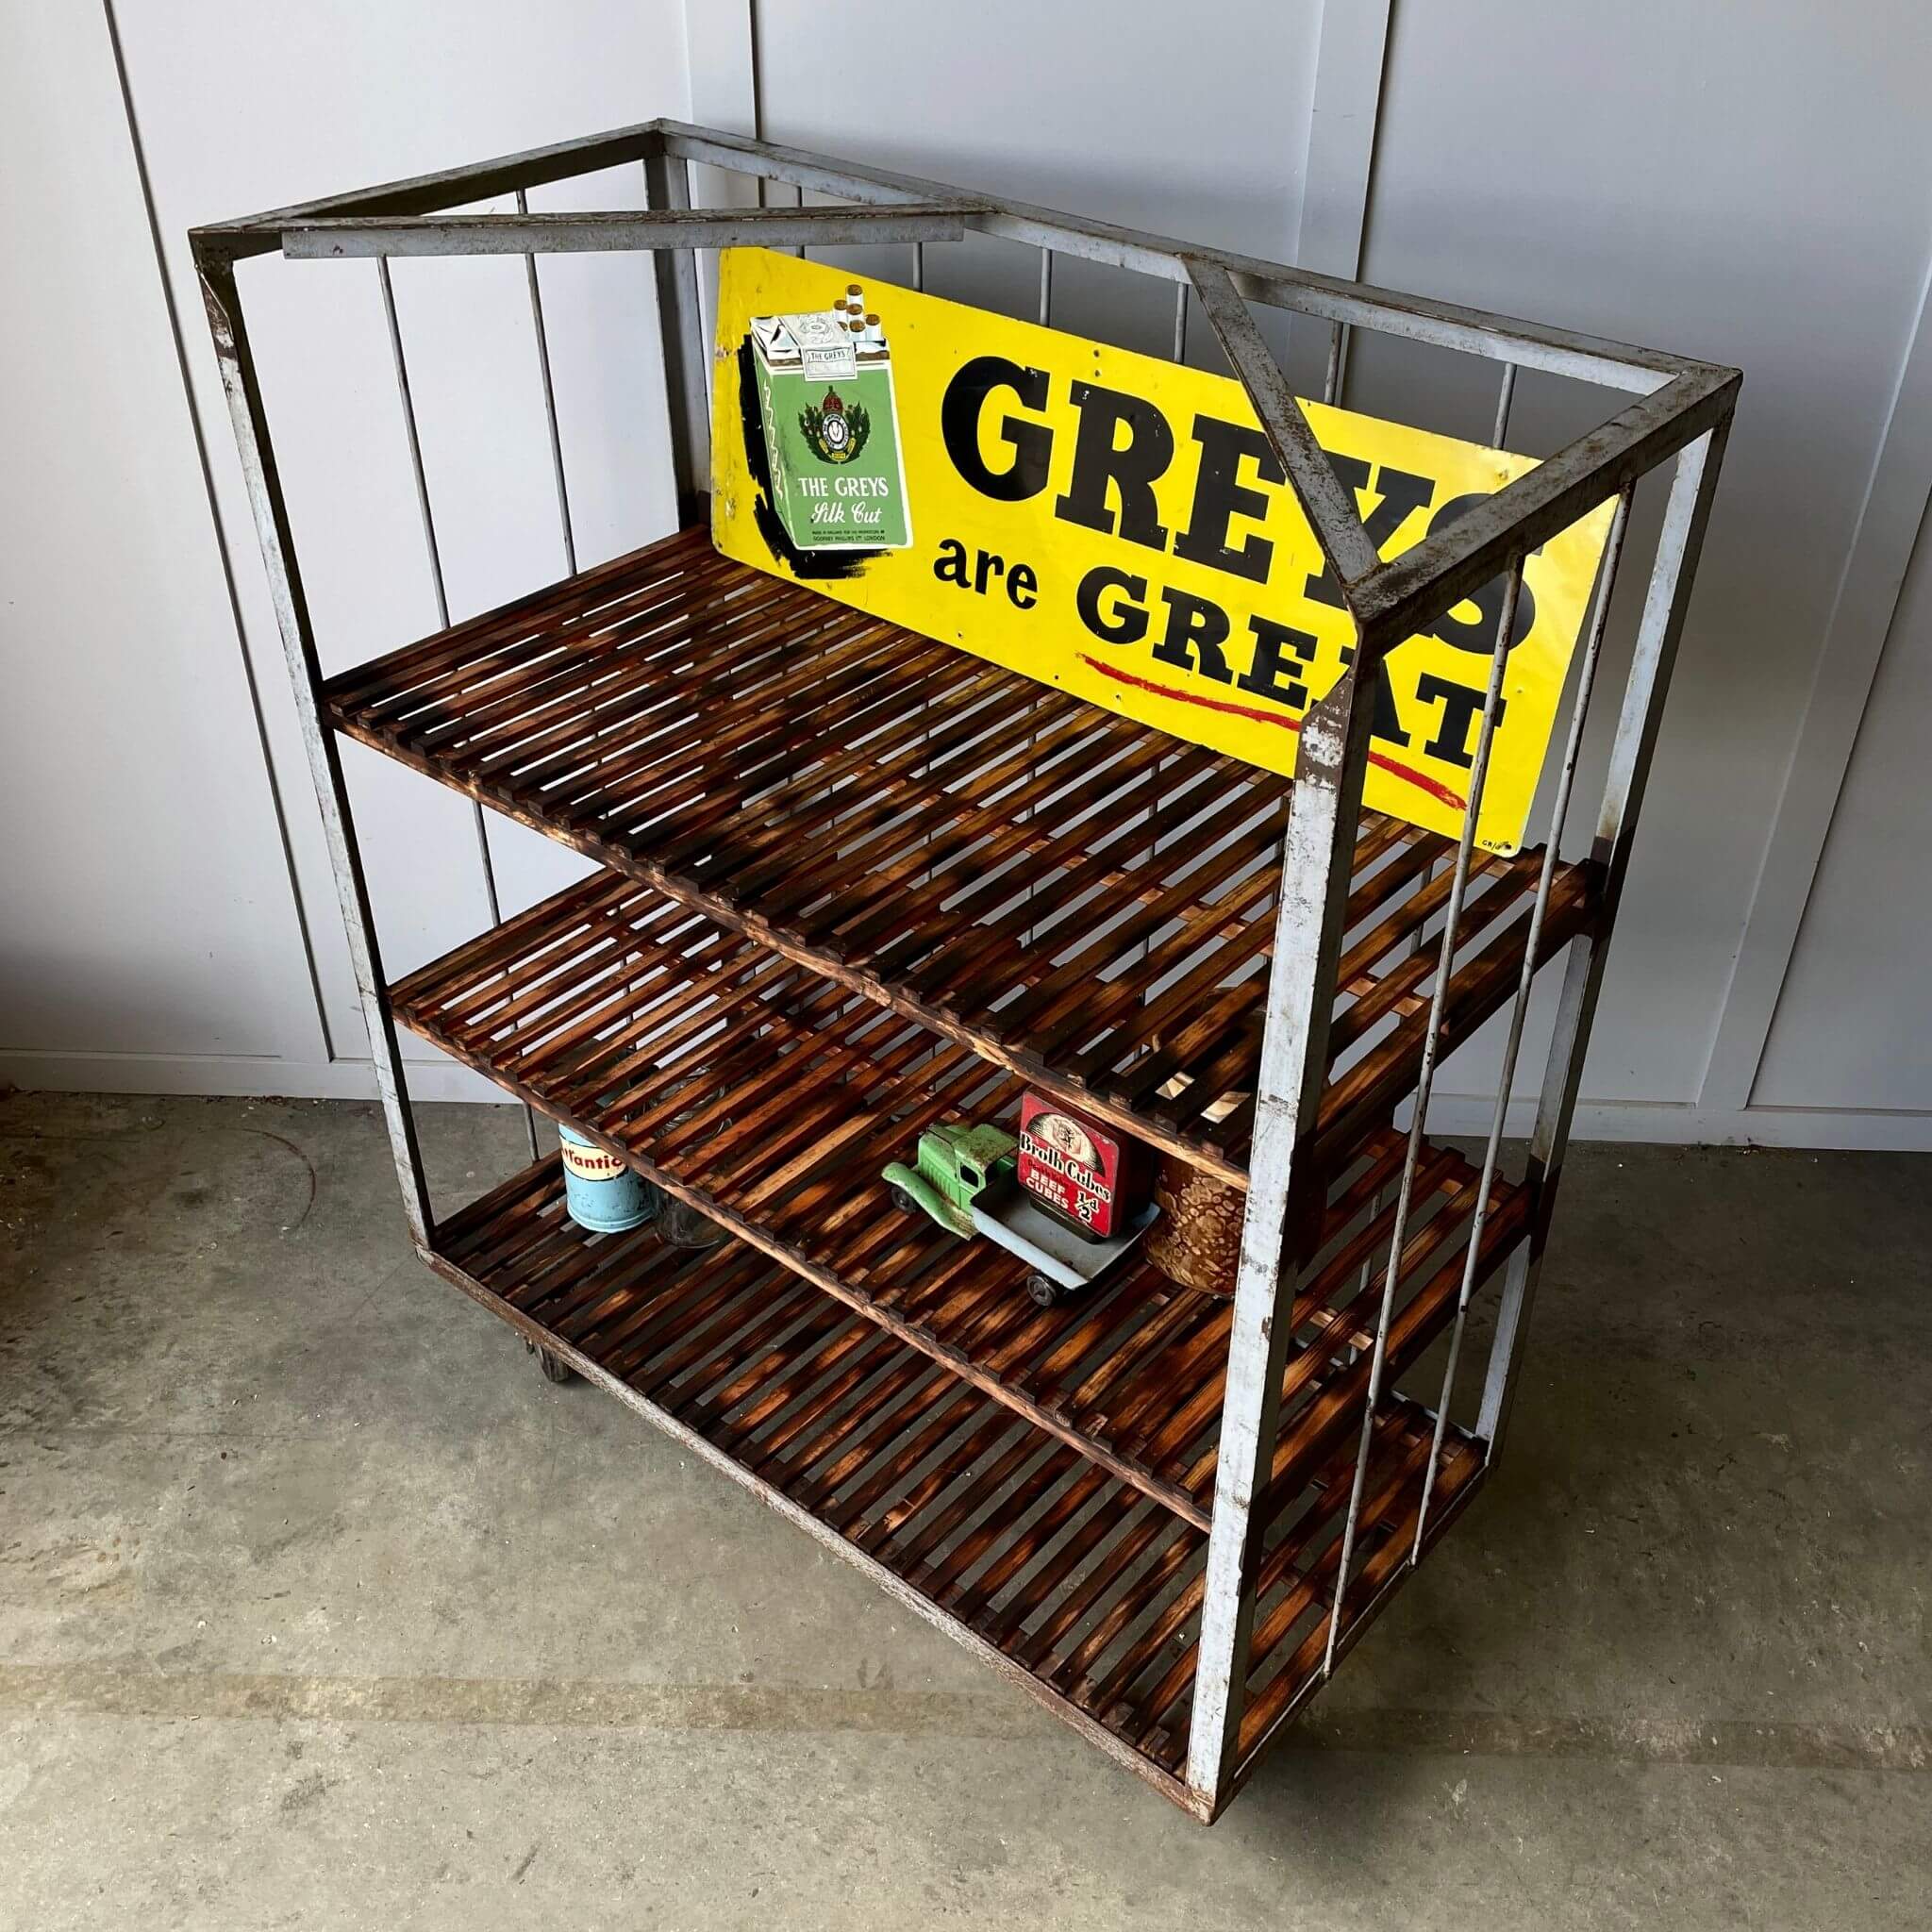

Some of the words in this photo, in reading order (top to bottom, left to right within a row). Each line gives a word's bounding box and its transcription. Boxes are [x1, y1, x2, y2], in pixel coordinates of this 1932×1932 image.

[797, 476, 829, 497] THE
[834, 476, 889, 497] GREYS
[811, 501, 846, 524] Silk
[851, 500, 883, 524] Cut
[933, 538, 1039, 610] are
[1025, 1176, 1069, 1209] CUBES
[1031, 1168, 1066, 1195] BEEF
[1065, 1159, 1111, 1204] Cubes
